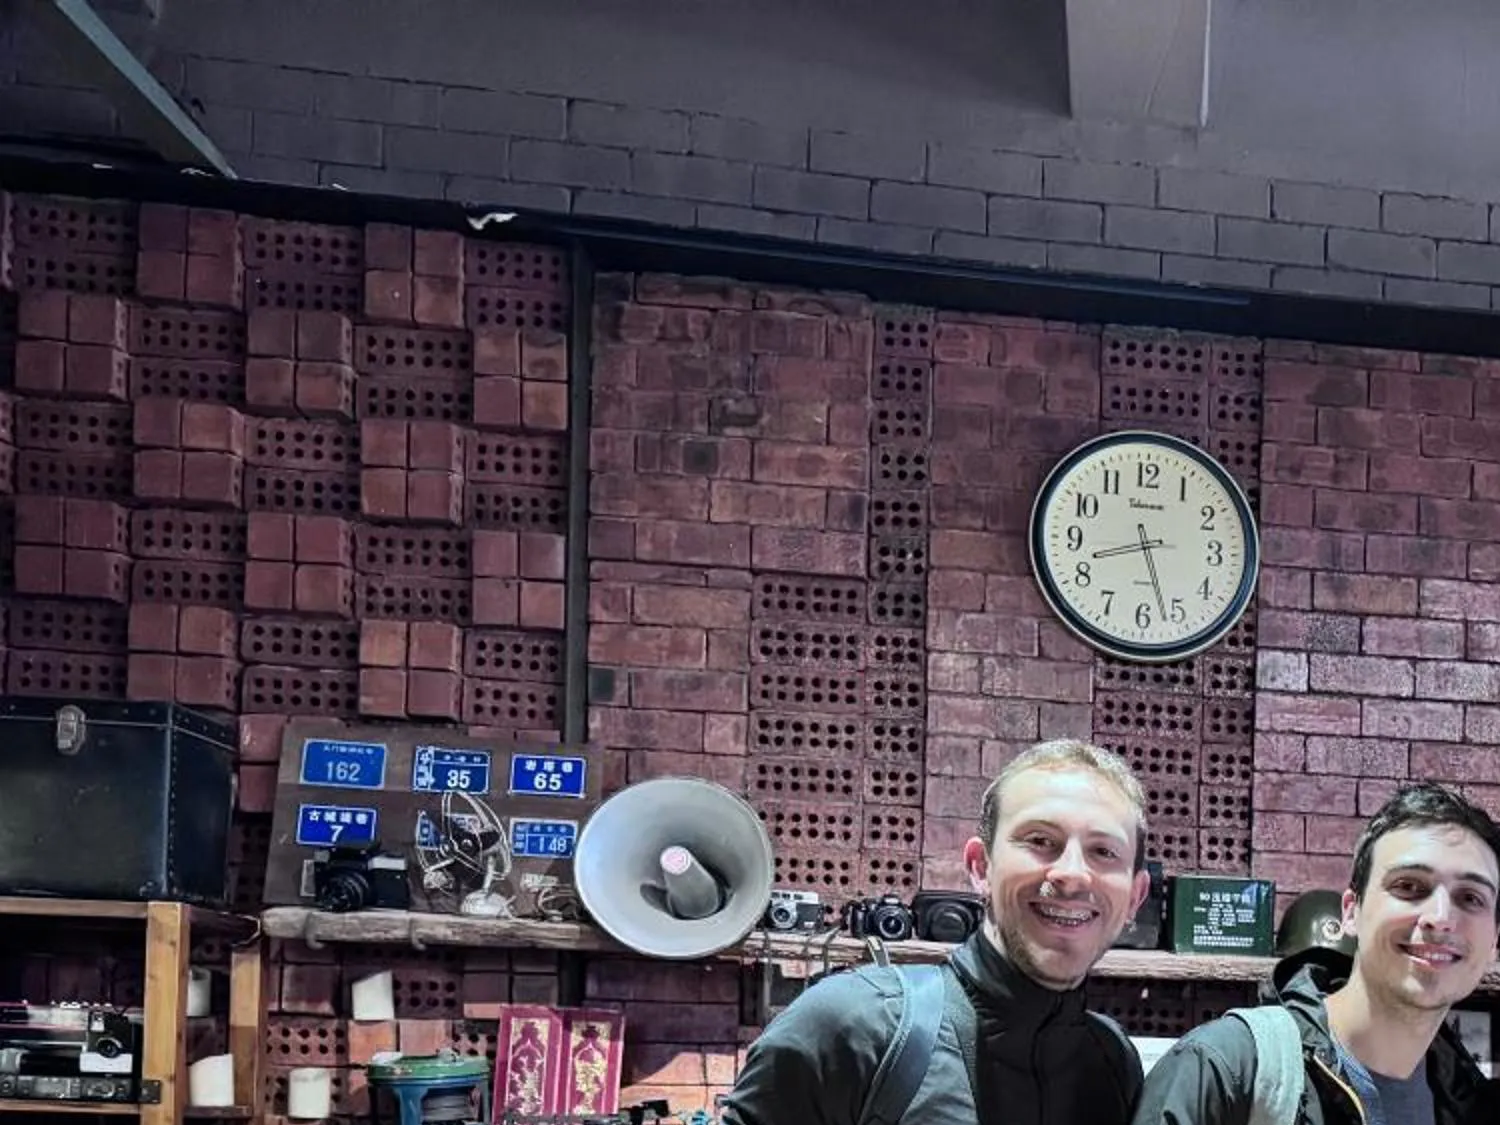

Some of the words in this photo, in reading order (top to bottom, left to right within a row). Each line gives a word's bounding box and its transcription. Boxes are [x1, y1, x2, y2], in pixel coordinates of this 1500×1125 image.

[1103, 469, 1120, 495] 11
[1136, 462, 1160, 489] 12
[1180, 476, 1187, 502] 1
[1075, 492, 1099, 519] 10
[1200, 505, 1215, 531] 2
[1067, 525, 1083, 551] 9
[1207, 540, 1223, 566] 3
[1075, 562, 1091, 588] 8
[1197, 576, 1213, 601] 4
[1100, 590, 1115, 616] 7
[1135, 603, 1151, 629] 6
[1170, 598, 1186, 624] 5
[326, 760, 361, 782] 162
[533, 772, 562, 791] 65
[329, 825, 344, 843] 7
